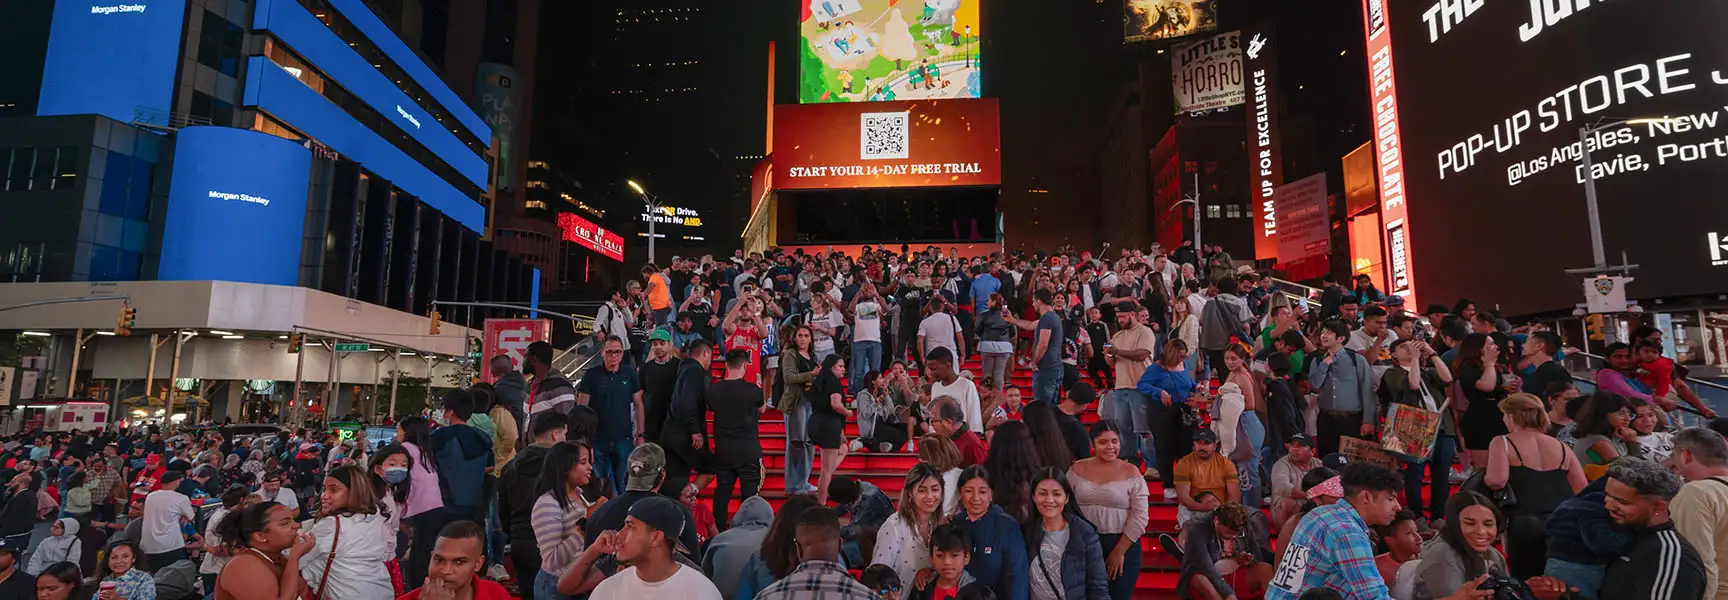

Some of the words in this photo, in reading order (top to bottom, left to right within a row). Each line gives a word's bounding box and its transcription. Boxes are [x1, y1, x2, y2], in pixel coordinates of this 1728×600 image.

[91, 5, 118, 14] Morgan
[118, 3, 146, 13] Stanley
[1182, 36, 1226, 66] LITTLE
[1230, 35, 1241, 49] S
[1182, 59, 1242, 104] HORRO
[1372, 45, 1392, 97] FREE
[1253, 69, 1270, 147] EXCELLENCE
[1438, 109, 1531, 180] POP-UP
[1537, 53, 1696, 133] STORE
[1260, 150, 1272, 177] FOR
[1376, 94, 1403, 210] CHOCOLATE
[1507, 155, 1548, 186] @Los
[1647, 111, 1719, 138] New
[789, 166, 828, 178] START
[829, 165, 864, 176] YOUR
[866, 164, 909, 176] 14-DAY
[910, 163, 942, 175] FREE
[943, 162, 982, 174] TRIAL
[208, 190, 240, 201] Morgan
[240, 193, 270, 206] Stanley
[1262, 180, 1274, 197] UP
[641, 213, 664, 223] Thre
[664, 215, 672, 223] Is
[672, 216, 684, 224] No
[645, 205, 664, 214] Txt
[676, 207, 699, 216] Drive.
[1264, 200, 1277, 237] TEAM
